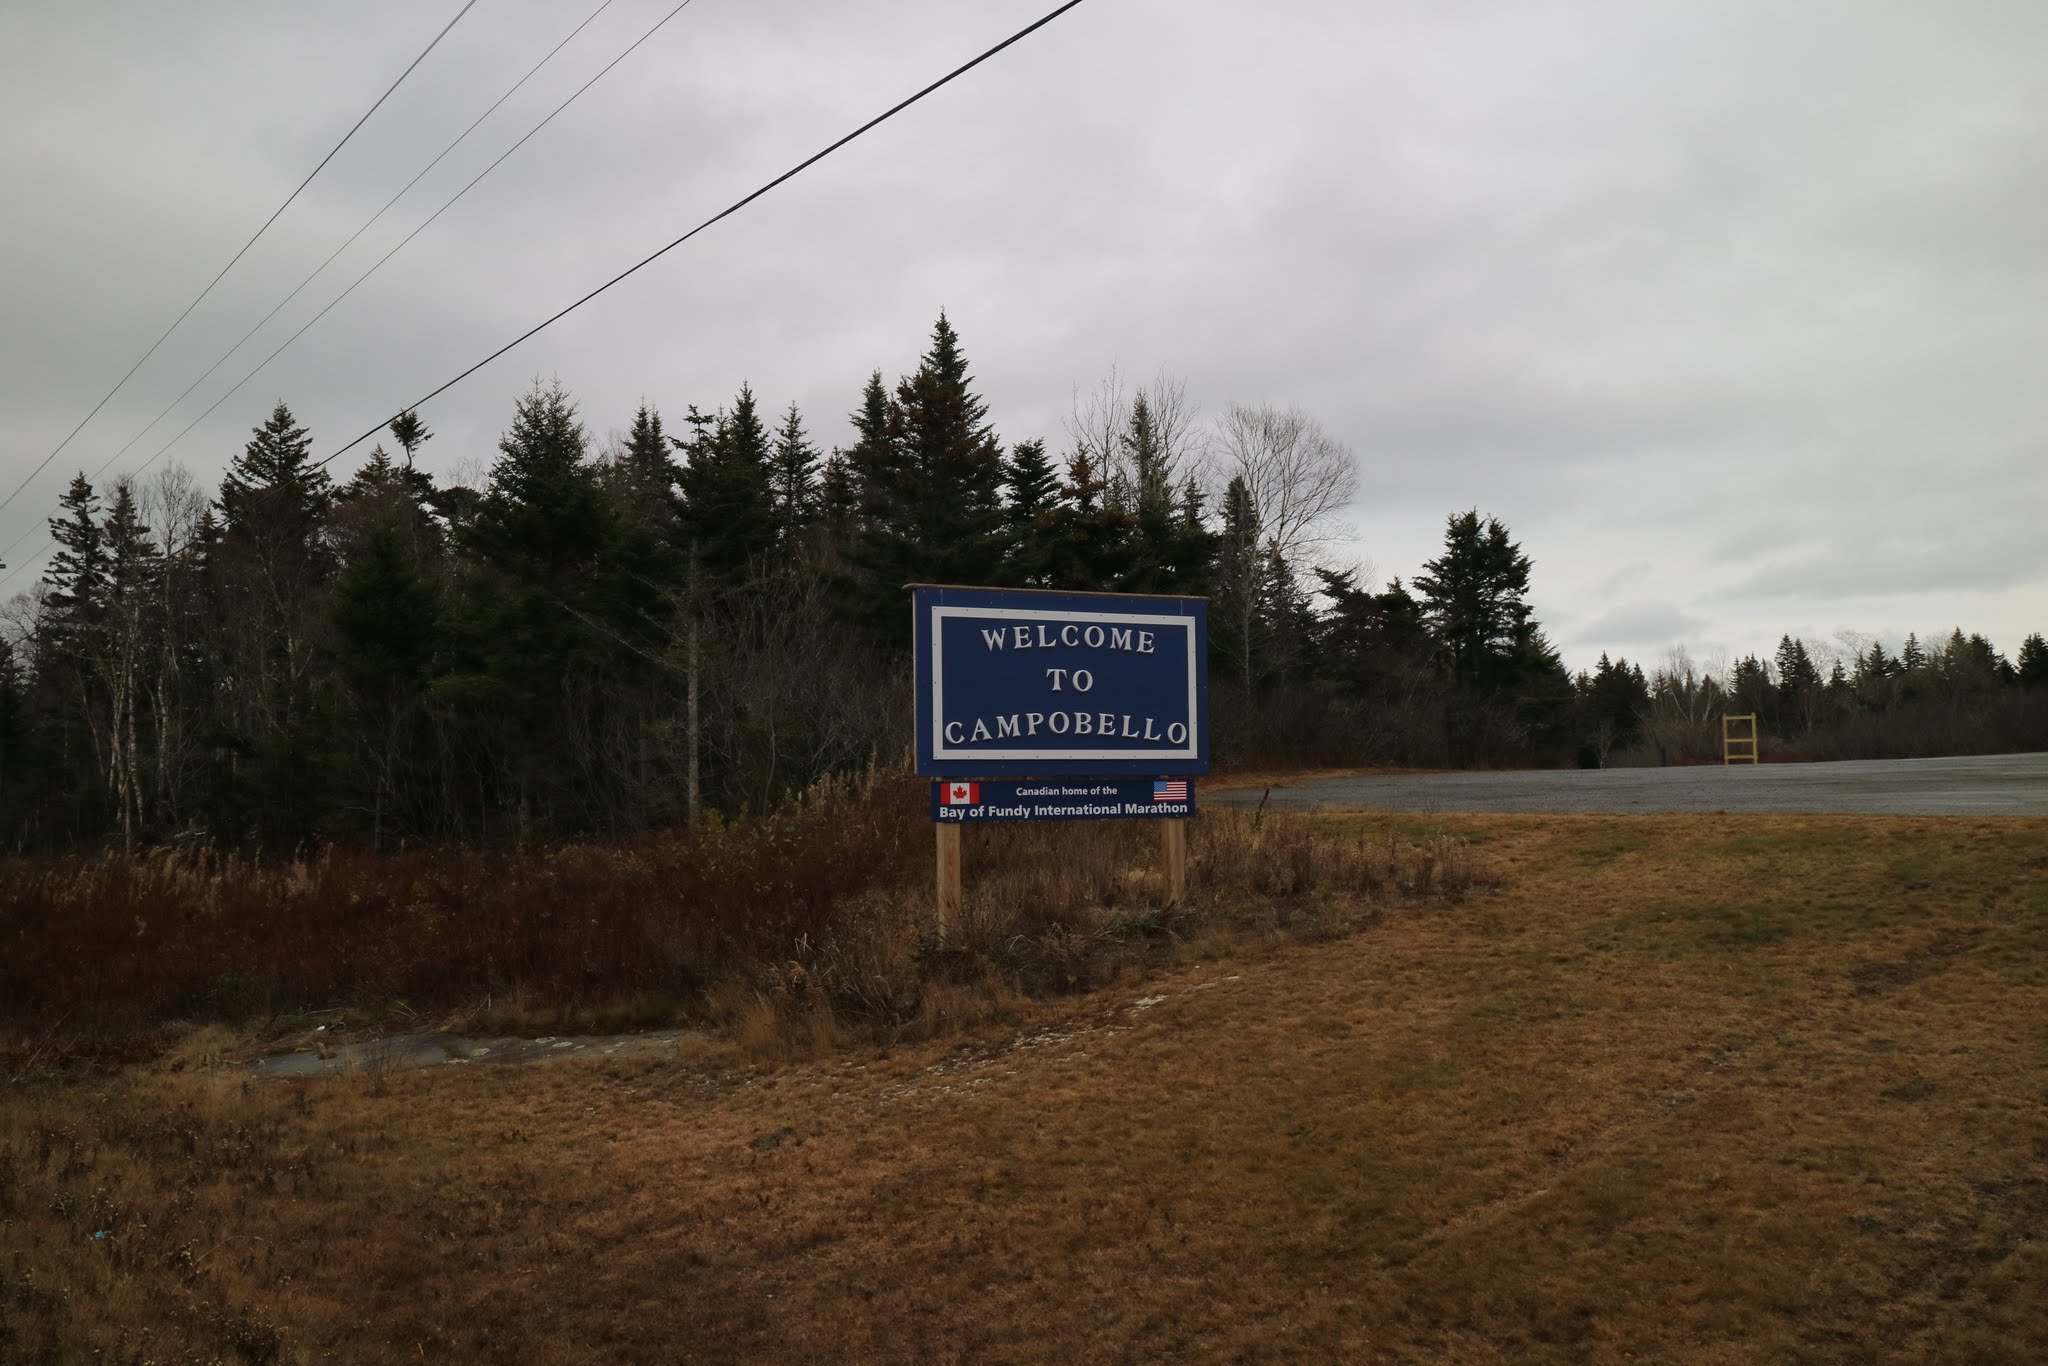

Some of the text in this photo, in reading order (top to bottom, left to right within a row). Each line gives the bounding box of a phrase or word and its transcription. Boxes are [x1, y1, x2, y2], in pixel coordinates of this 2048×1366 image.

[980, 625, 1156, 654] WELCOME
[1046, 668, 1094, 692] TO
[944, 711, 1188, 744] CAMPOBELLO
[1016, 786, 1118, 796] Canadian home of the
[939, 802, 1188, 820] Bay of Fundy International Marathon
